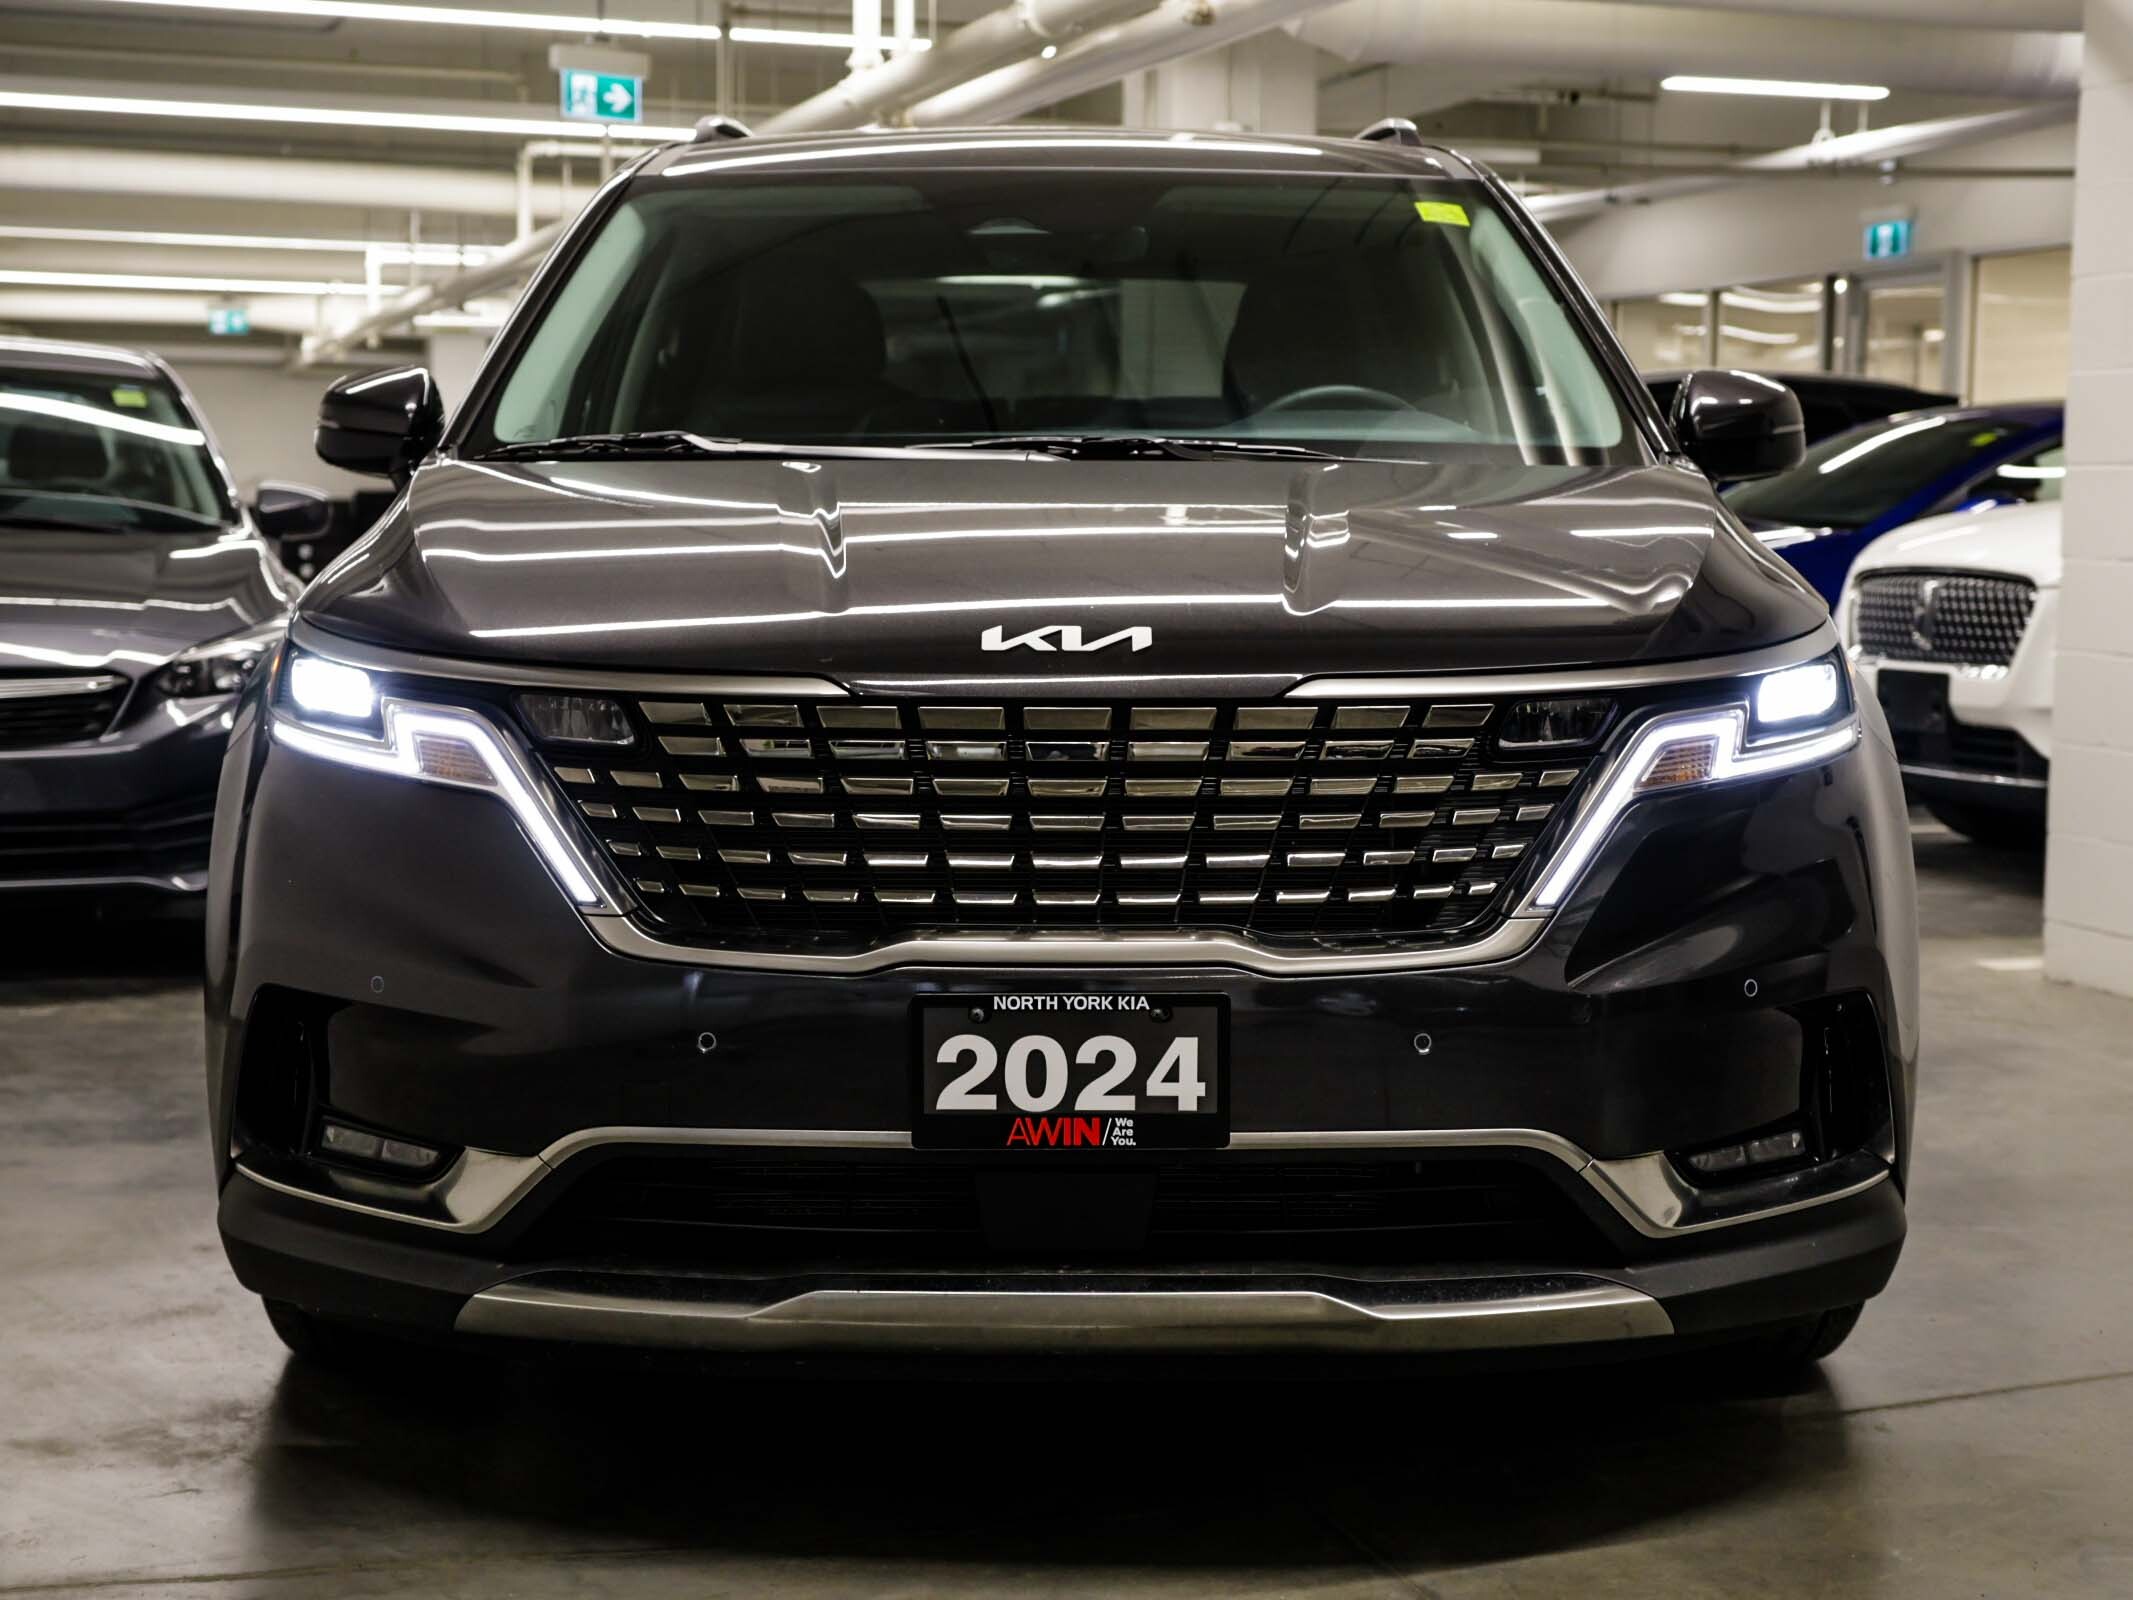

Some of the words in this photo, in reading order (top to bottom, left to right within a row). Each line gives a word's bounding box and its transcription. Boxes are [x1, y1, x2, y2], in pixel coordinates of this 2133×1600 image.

[993, 996, 1058, 1010] NORTH
[1062, 996, 1113, 1010] YORK
[1118, 996, 1150, 1010] KIA
[936, 1034, 1206, 1113] 2024
[1114, 1117, 1134, 1127] We
[1006, 1117, 1100, 1146] AWIN
[1112, 1127, 1134, 1136] Are
[1110, 1136, 1137, 1146] You.
